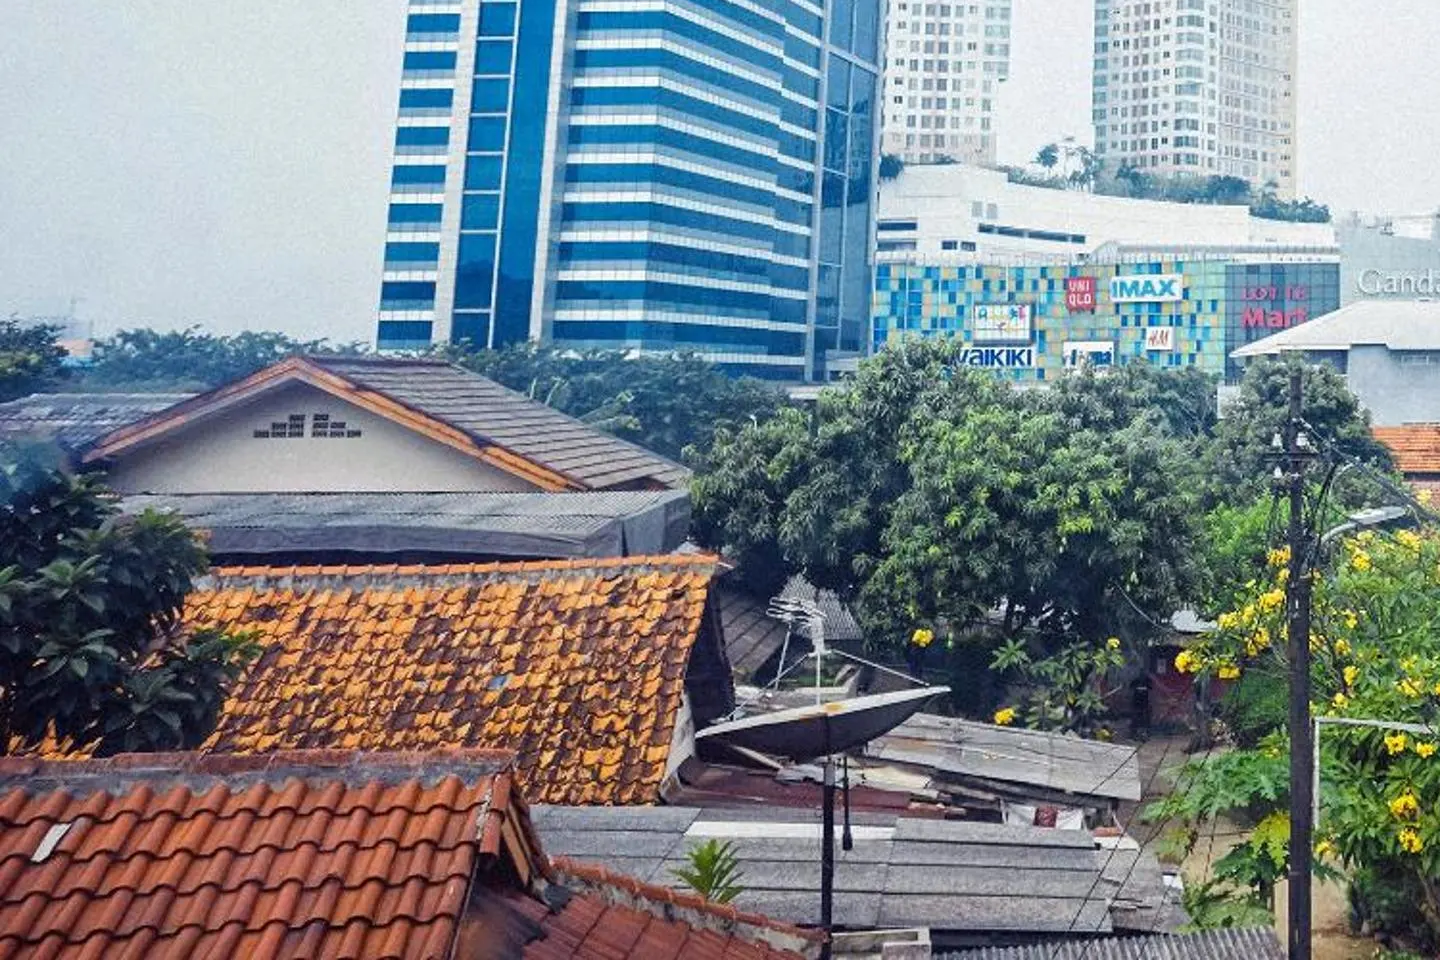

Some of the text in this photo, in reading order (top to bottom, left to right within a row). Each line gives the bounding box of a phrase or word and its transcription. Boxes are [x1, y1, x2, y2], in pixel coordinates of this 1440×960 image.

[1069, 280, 1090, 292] UNI
[1112, 280, 1176, 298] IMAX
[1069, 293, 1091, 306] QLO
[1243, 307, 1307, 329] Mart
